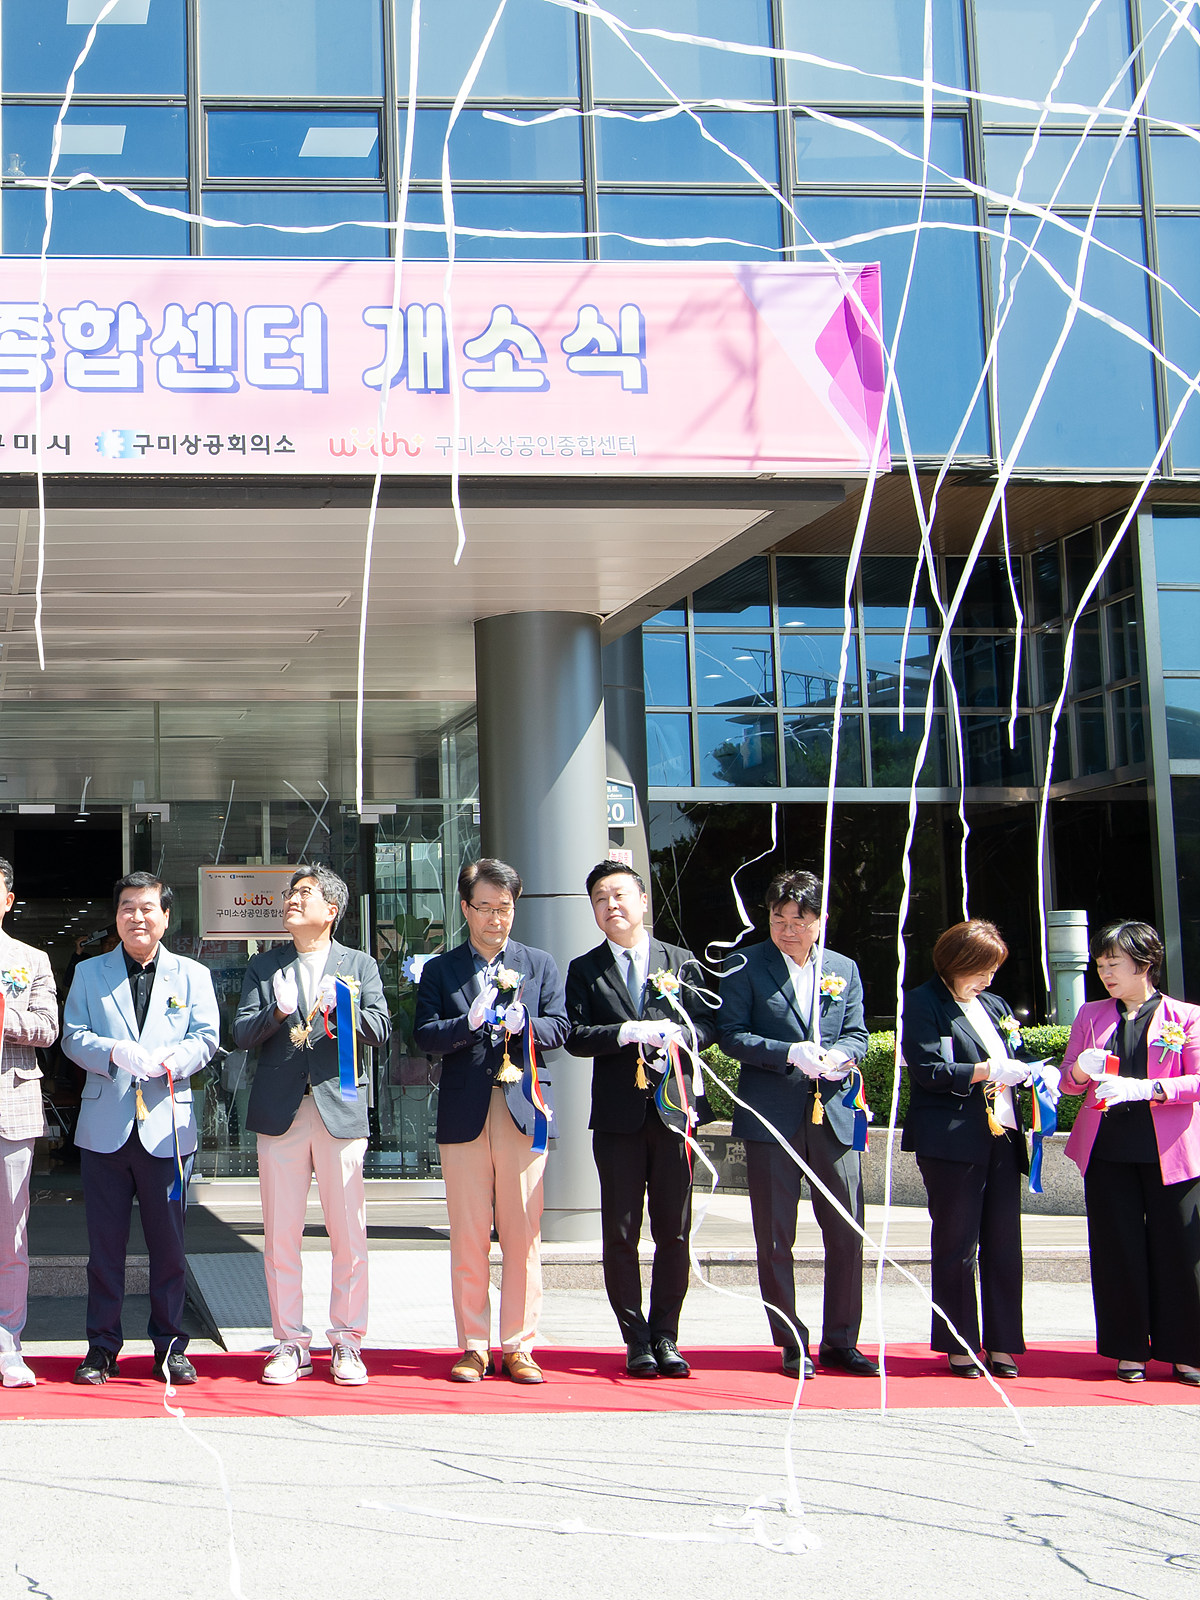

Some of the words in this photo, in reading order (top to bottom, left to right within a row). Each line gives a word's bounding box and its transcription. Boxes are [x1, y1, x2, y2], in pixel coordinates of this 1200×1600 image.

[362, 302, 648, 395] 개소식
[132, 434, 296, 456] 구미상공회의소
[434, 435, 639, 457] 구미소상공인종합센터
